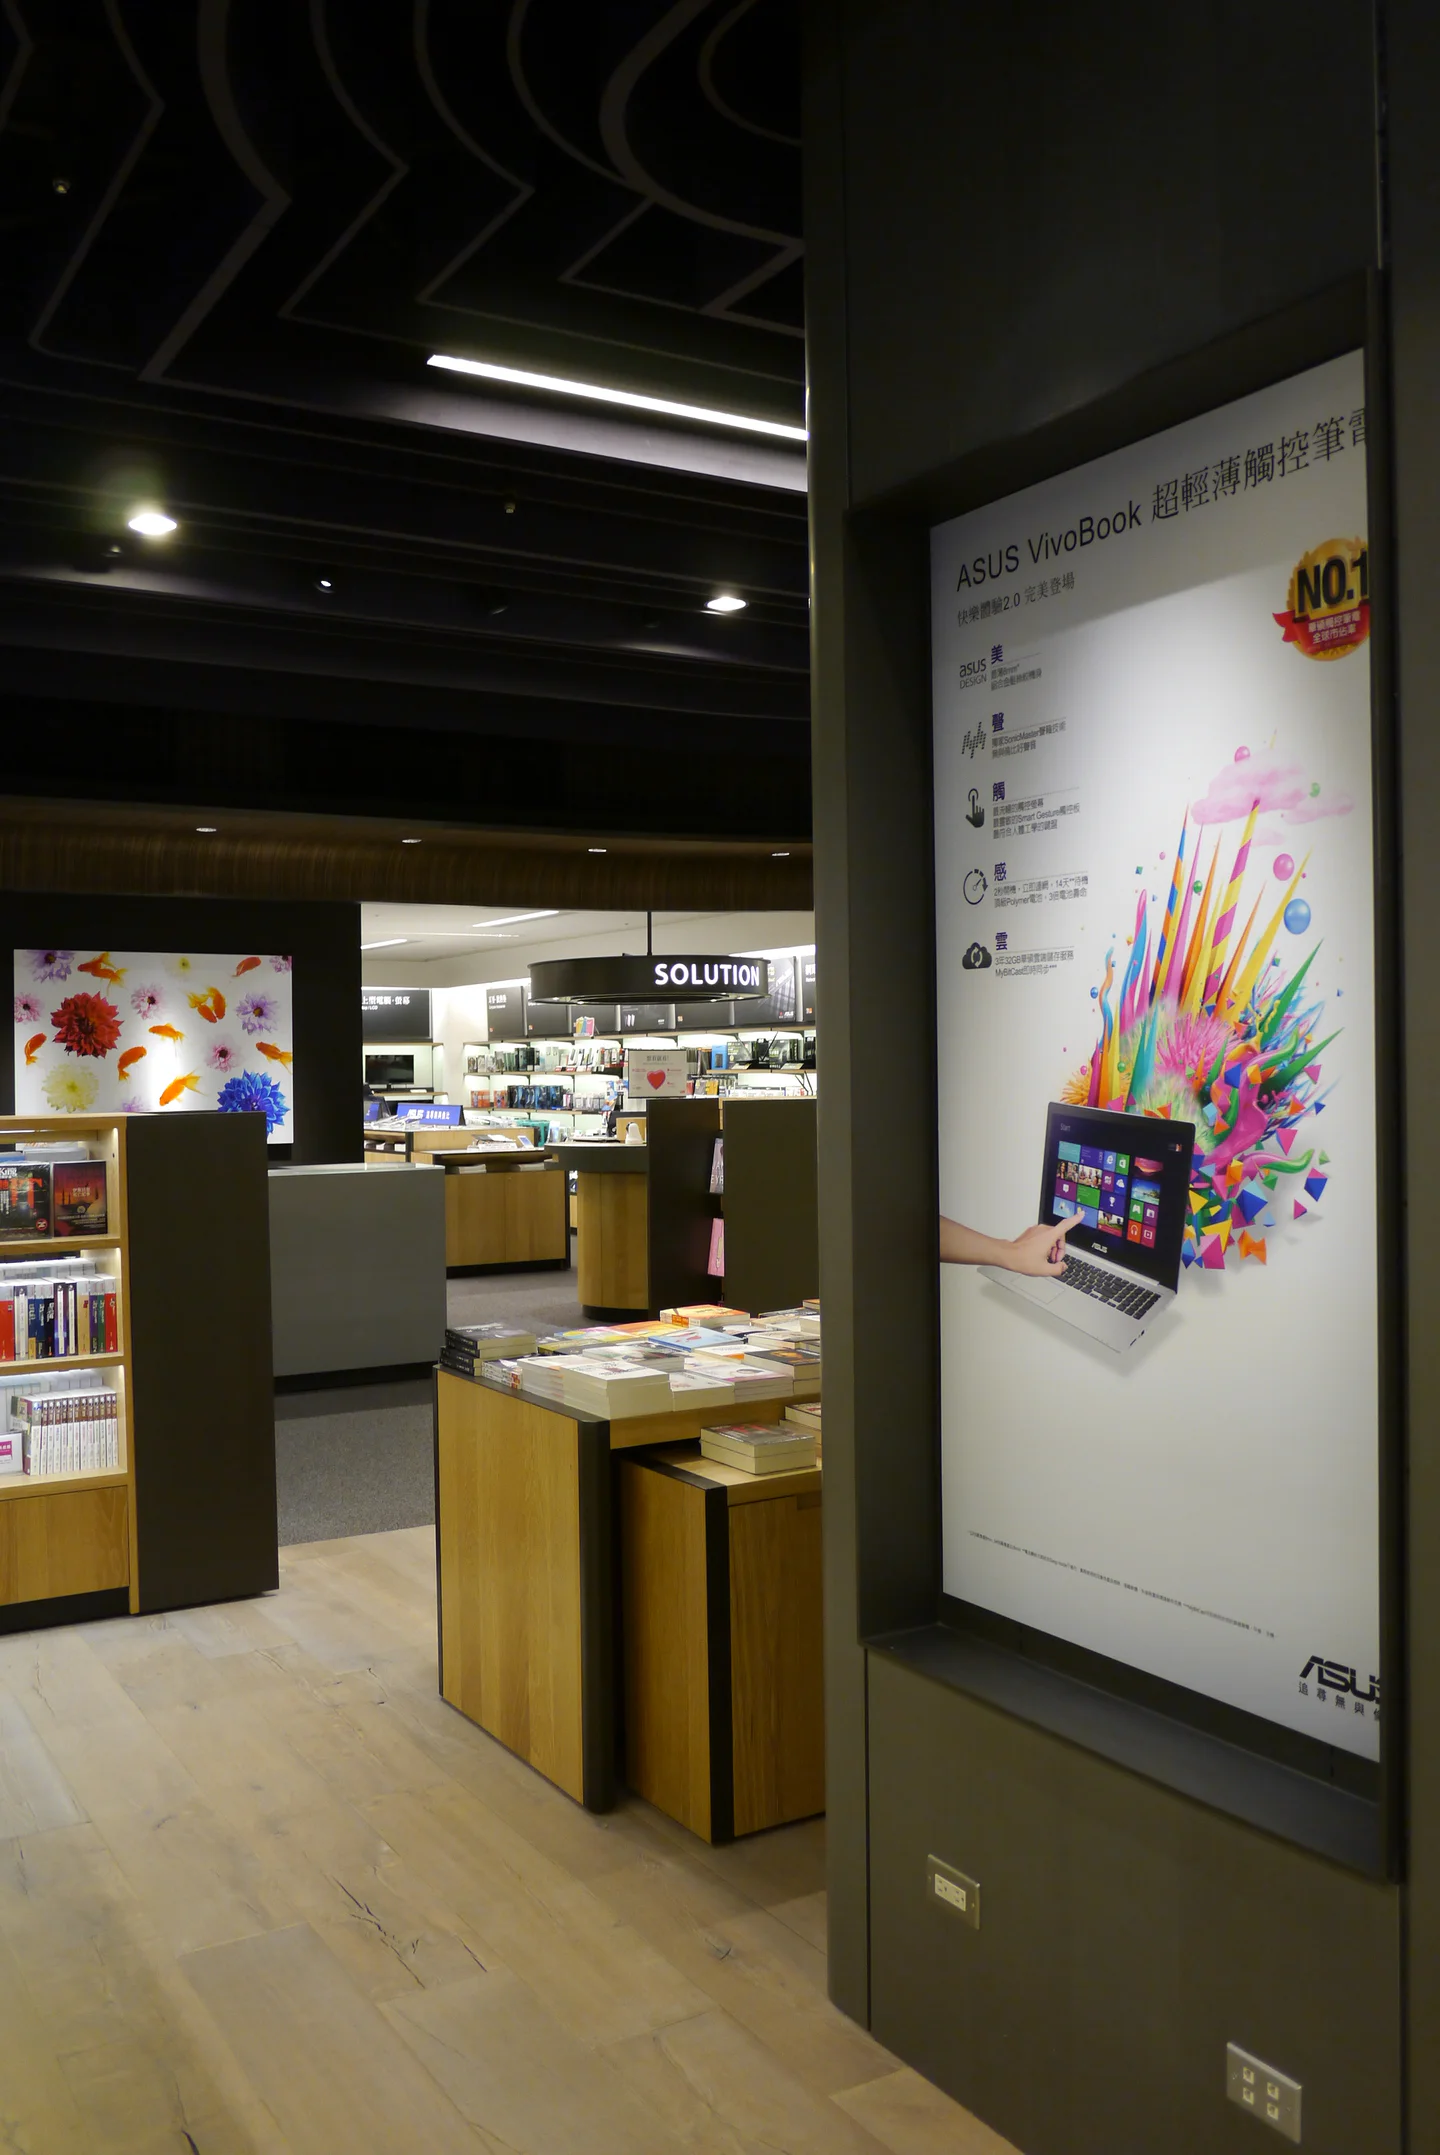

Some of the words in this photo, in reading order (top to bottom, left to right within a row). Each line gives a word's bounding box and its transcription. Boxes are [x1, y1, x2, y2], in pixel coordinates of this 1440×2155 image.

[955, 543, 1021, 592] ASUS
[1027, 500, 1143, 565] VivoBook
[1297, 548, 1368, 614] NO.1
[957, 592, 1021, 627] 快樂體驗2.0
[1024, 571, 1075, 605] 完美登場
[991, 643, 1003, 664] 美
[959, 658, 987, 678] asus
[959, 674, 987, 689] DESIGN
[992, 781, 1006, 802] 觸
[994, 862, 1007, 882] 感
[995, 931, 1008, 951] 雲
[654, 963, 760, 987] SOLUTION
[1091, 1241, 1108, 1254] ASUS
[1299, 1655, 1380, 1705] ASU
